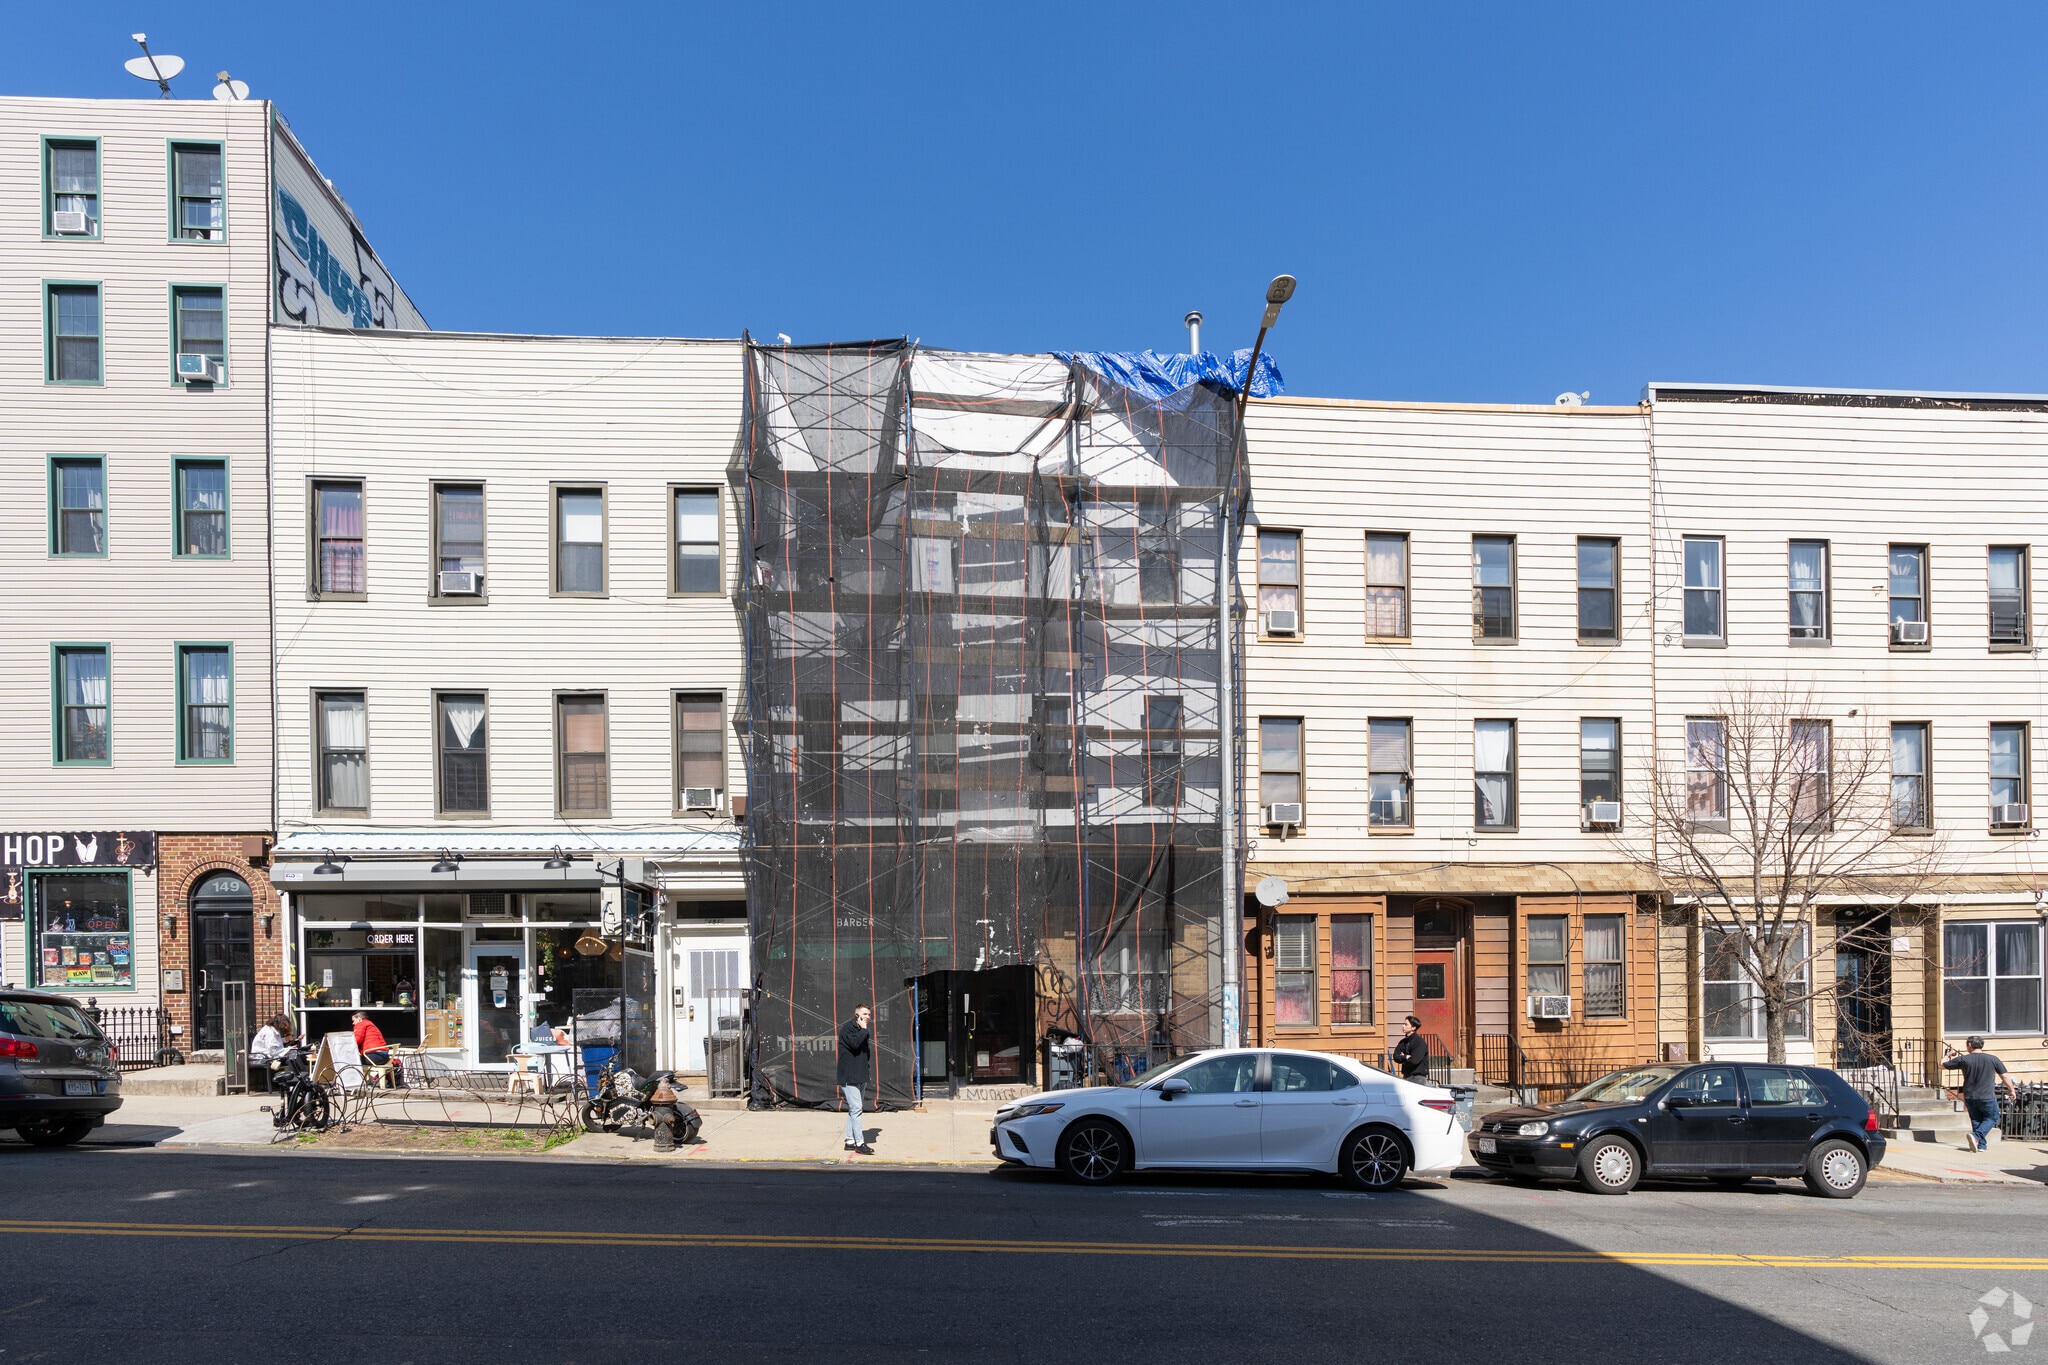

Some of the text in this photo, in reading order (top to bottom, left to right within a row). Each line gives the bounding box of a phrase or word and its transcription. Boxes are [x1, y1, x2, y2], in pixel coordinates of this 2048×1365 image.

[4, 835, 64, 865] HOP
[212, 881, 240, 892] 149
[87, 920, 119, 929] OPEN
[836, 917, 875, 927] BARBER
[366, 934, 414, 944] ORDER HERE
